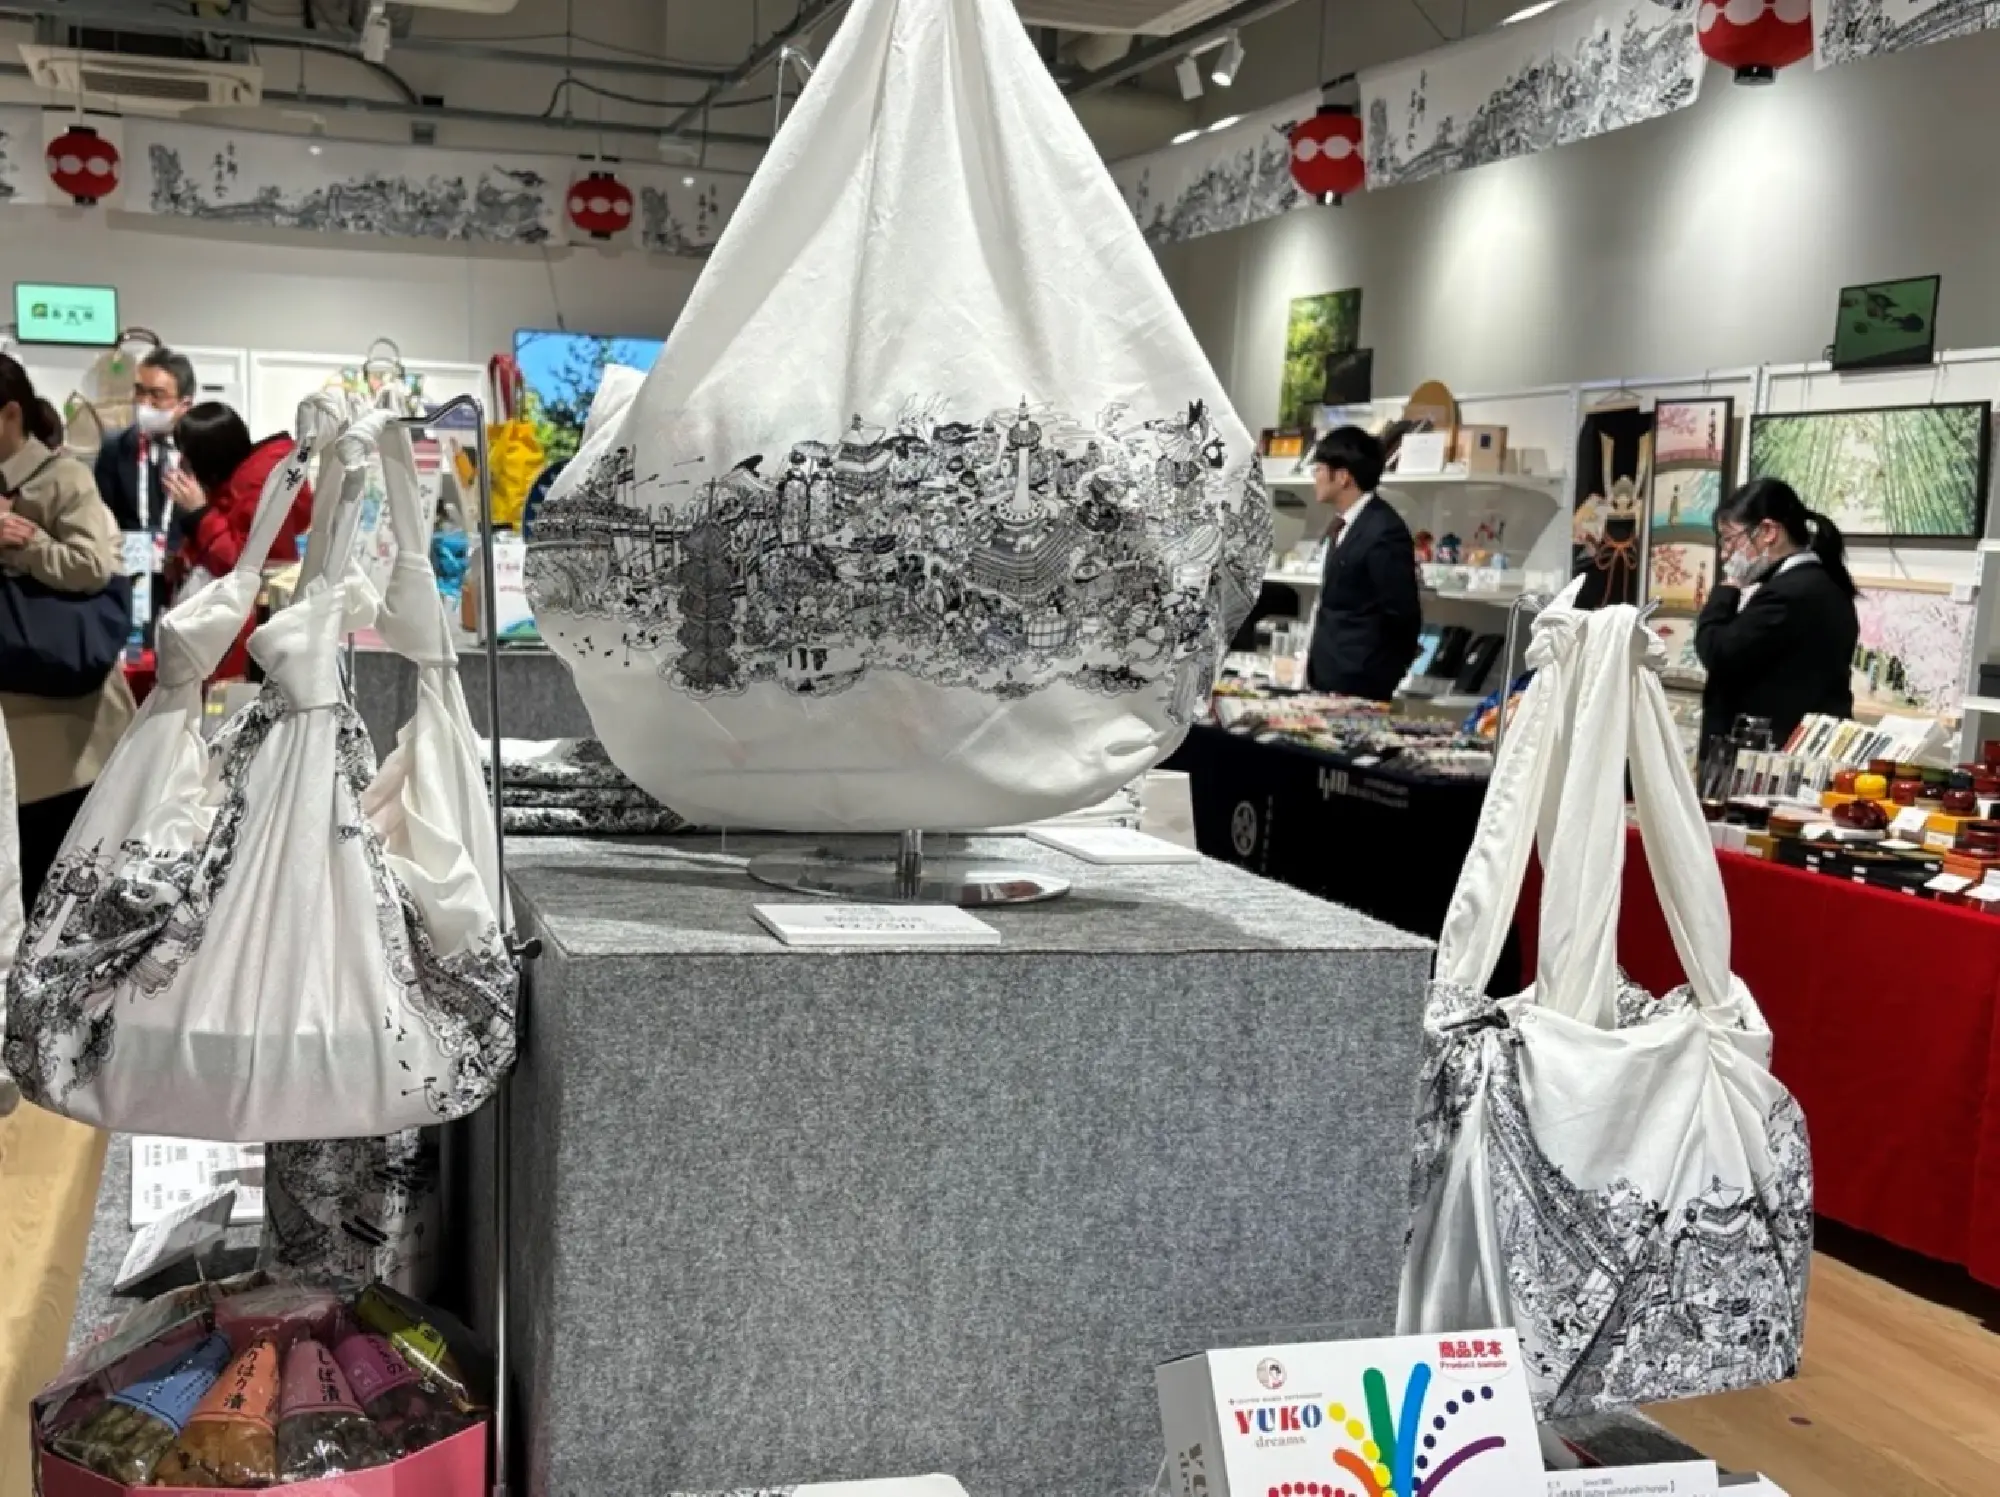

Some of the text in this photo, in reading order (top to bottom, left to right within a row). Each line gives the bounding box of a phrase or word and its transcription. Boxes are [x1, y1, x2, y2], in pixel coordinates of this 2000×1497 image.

[1439, 1340, 1503, 1358] 商品見本
[1440, 1360, 1507, 1369] Product sample
[1234, 1404, 1322, 1434] YUKO
[1256, 1436, 1305, 1448] dreams
